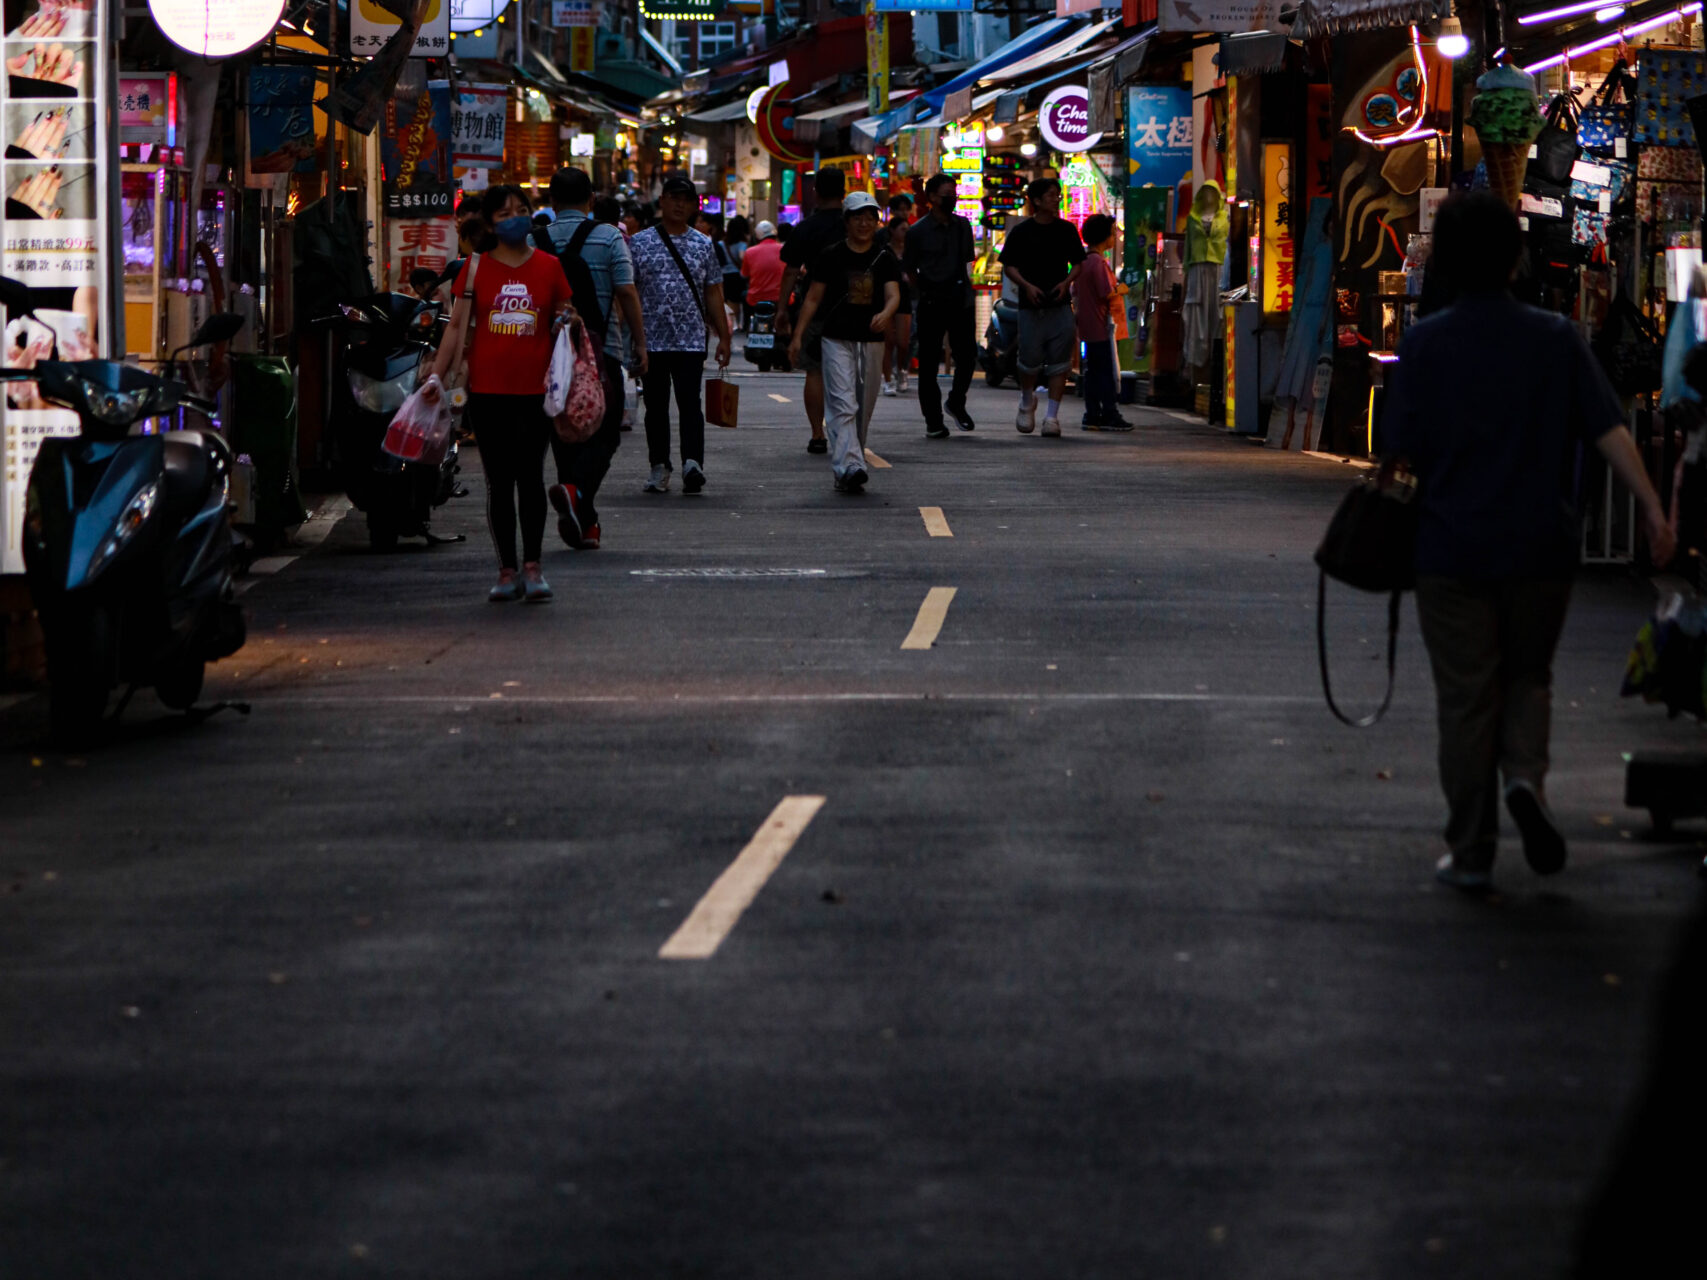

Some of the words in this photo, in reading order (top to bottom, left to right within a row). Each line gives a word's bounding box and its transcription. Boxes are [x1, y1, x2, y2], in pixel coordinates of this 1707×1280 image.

[353, 35, 447, 48] 老天椒餅
[119, 94, 151, 112] 売機
[1057, 104, 1088, 119] Cha
[1056, 118, 1088, 134] time
[1134, 115, 1193, 148] 太極
[500, 297, 530, 314] 100
